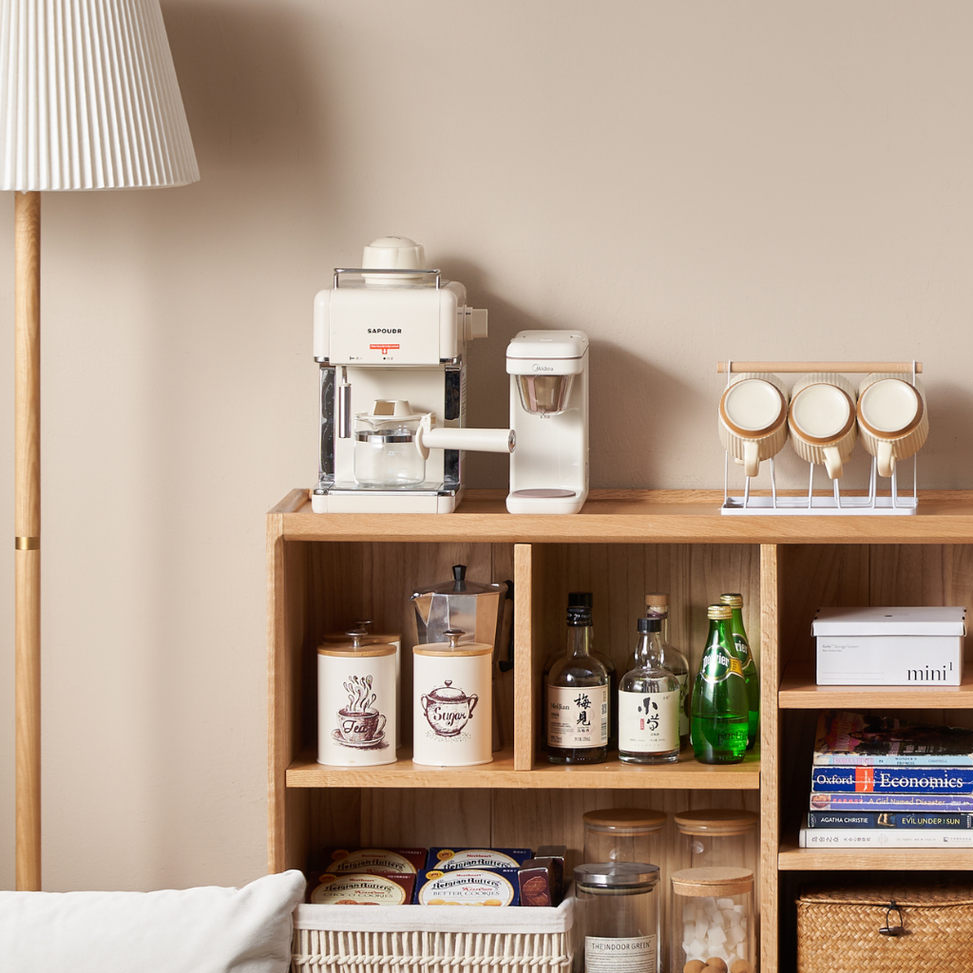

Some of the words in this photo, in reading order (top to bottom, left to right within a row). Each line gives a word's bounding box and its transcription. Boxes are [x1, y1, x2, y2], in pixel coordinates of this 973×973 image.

[433, 706, 467, 726] Sugar
[342, 719, 368, 734] Tea
[816, 774, 853, 786] Oxford
[880, 771, 963, 788] Economics
[874, 796, 889, 804] Girl
[915, 796, 946, 805] Disaster
[901, 817, 917, 825] EVIL
[631, 941, 650, 950] GREEN
